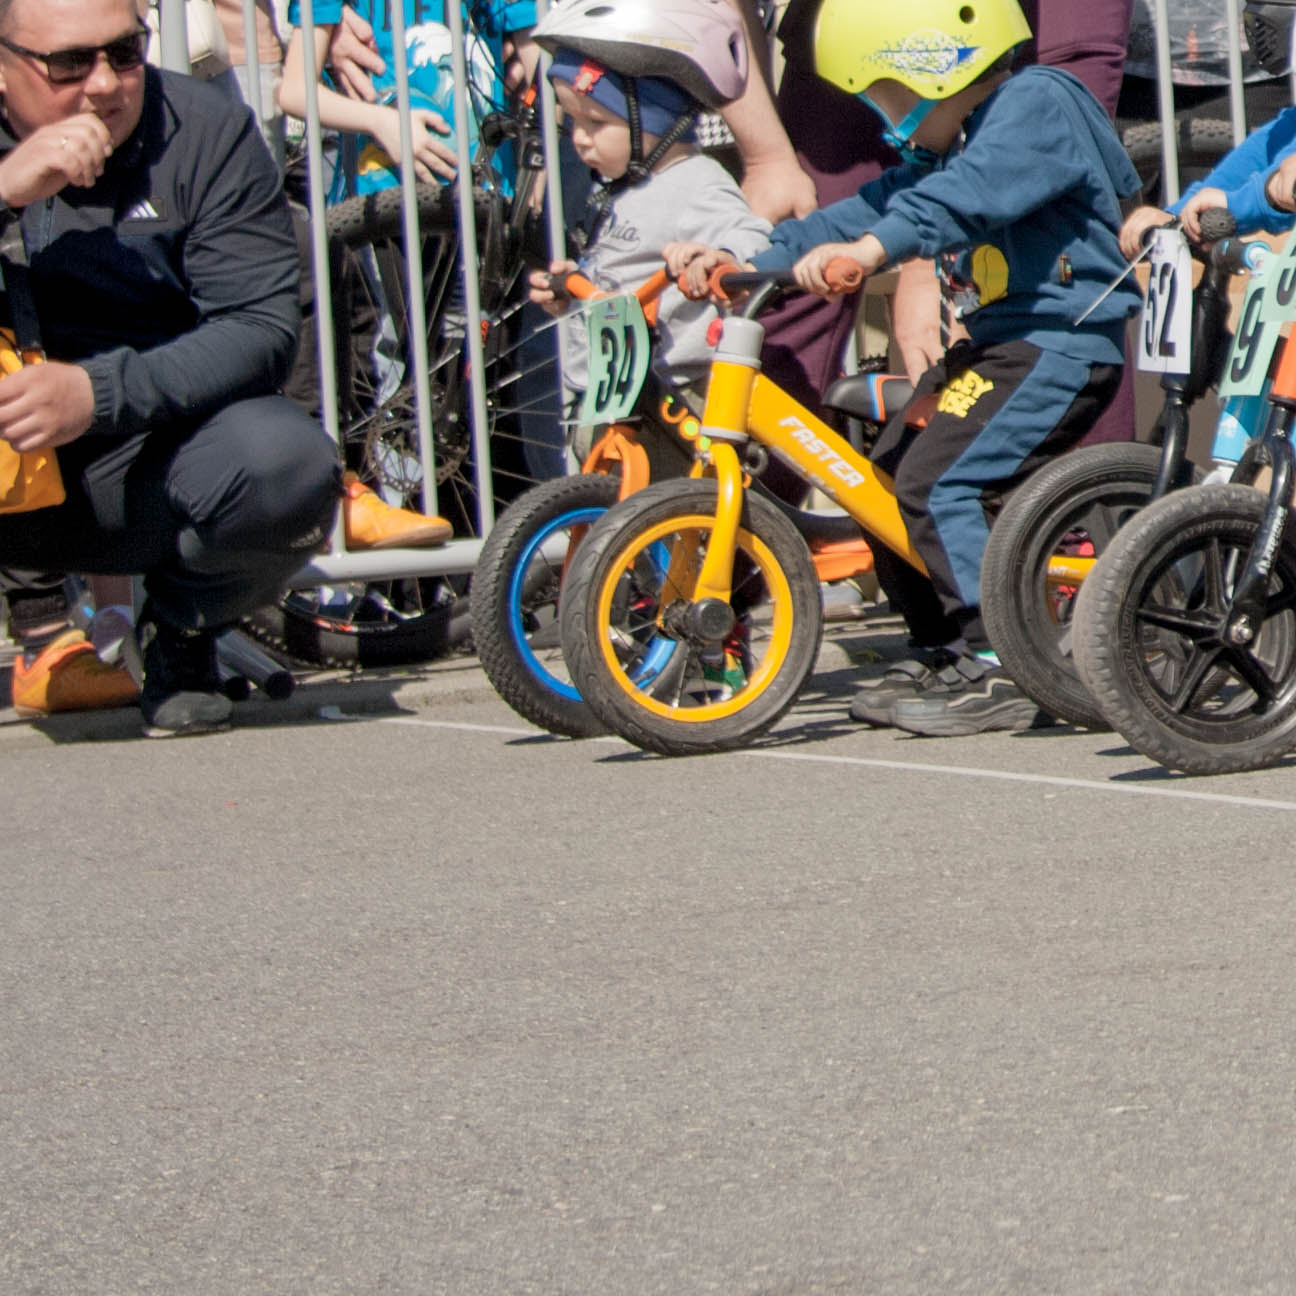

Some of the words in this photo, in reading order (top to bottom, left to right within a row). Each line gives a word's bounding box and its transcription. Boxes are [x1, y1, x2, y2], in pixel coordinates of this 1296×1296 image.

[1144, 261, 1176, 358] 52
[595, 324, 637, 413] 34
[778, 415, 865, 489] FASTER
